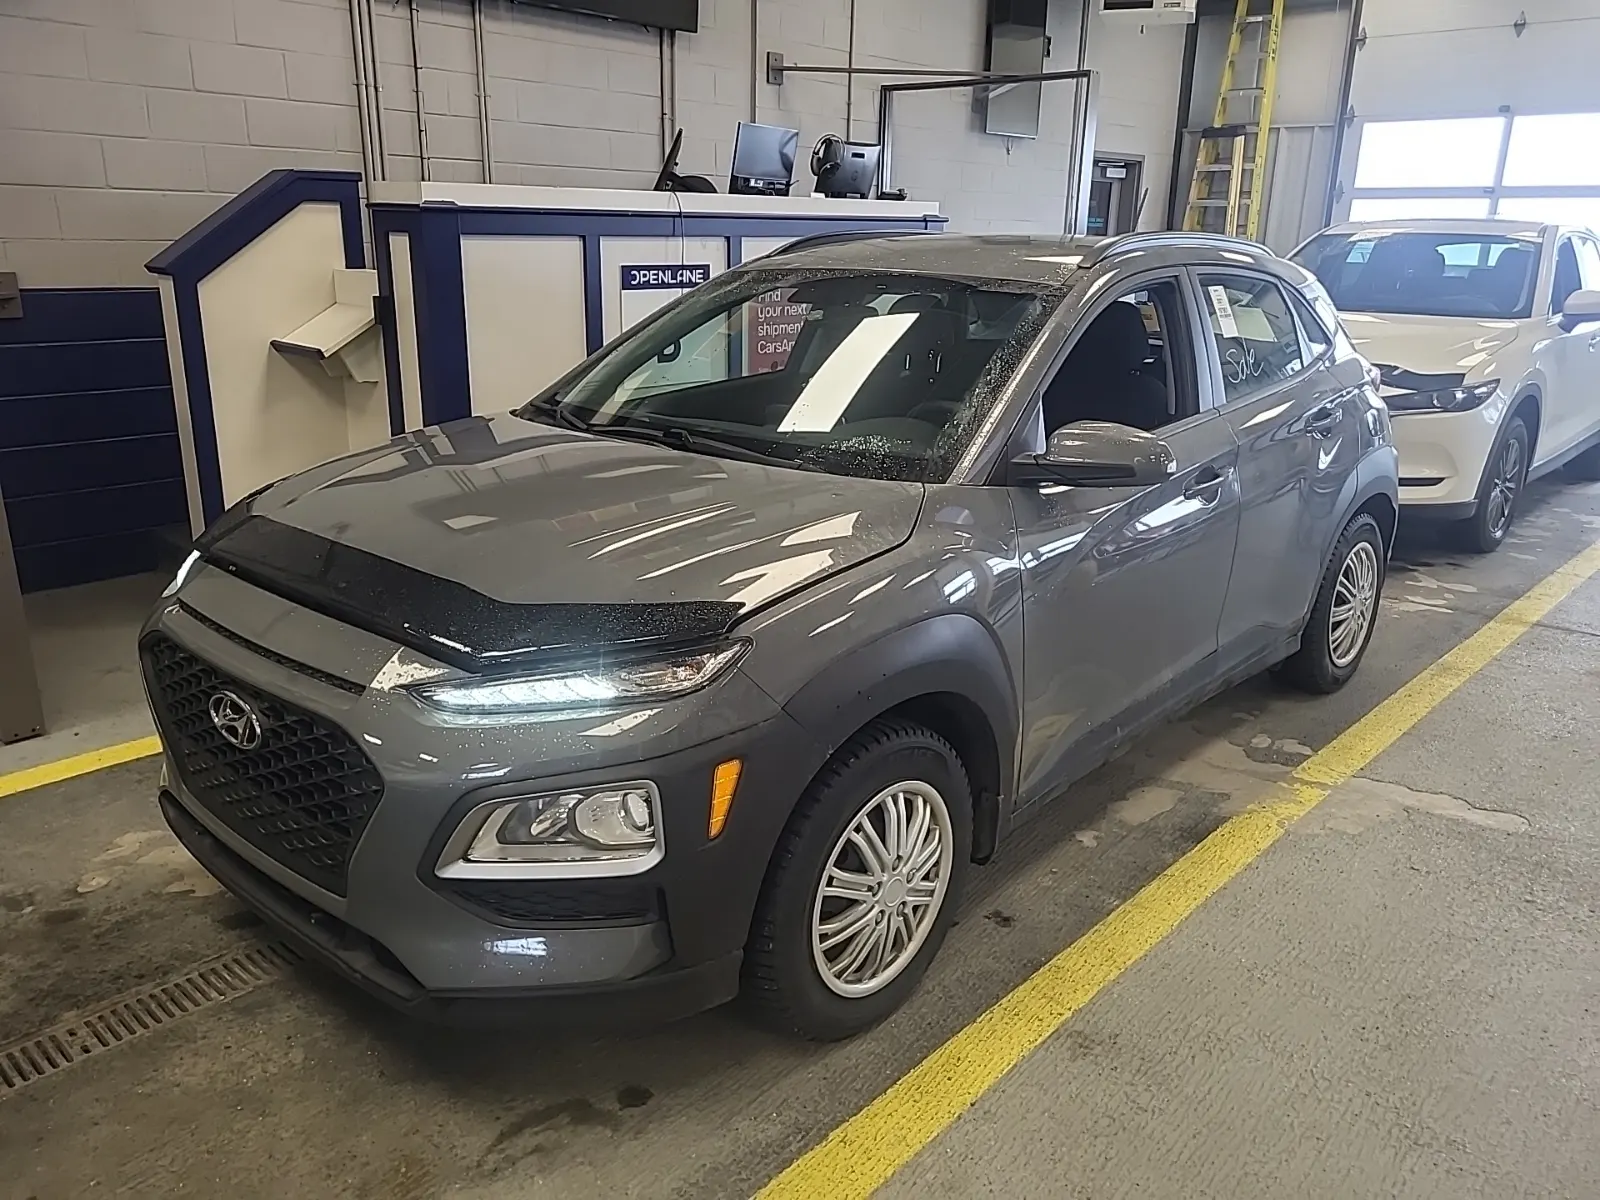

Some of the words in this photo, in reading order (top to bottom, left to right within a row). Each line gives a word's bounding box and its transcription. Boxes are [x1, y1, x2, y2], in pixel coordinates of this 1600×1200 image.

[630, 269, 704, 285] OPENLANE
[758, 306, 783, 322] your
[784, 303, 807, 317] next
